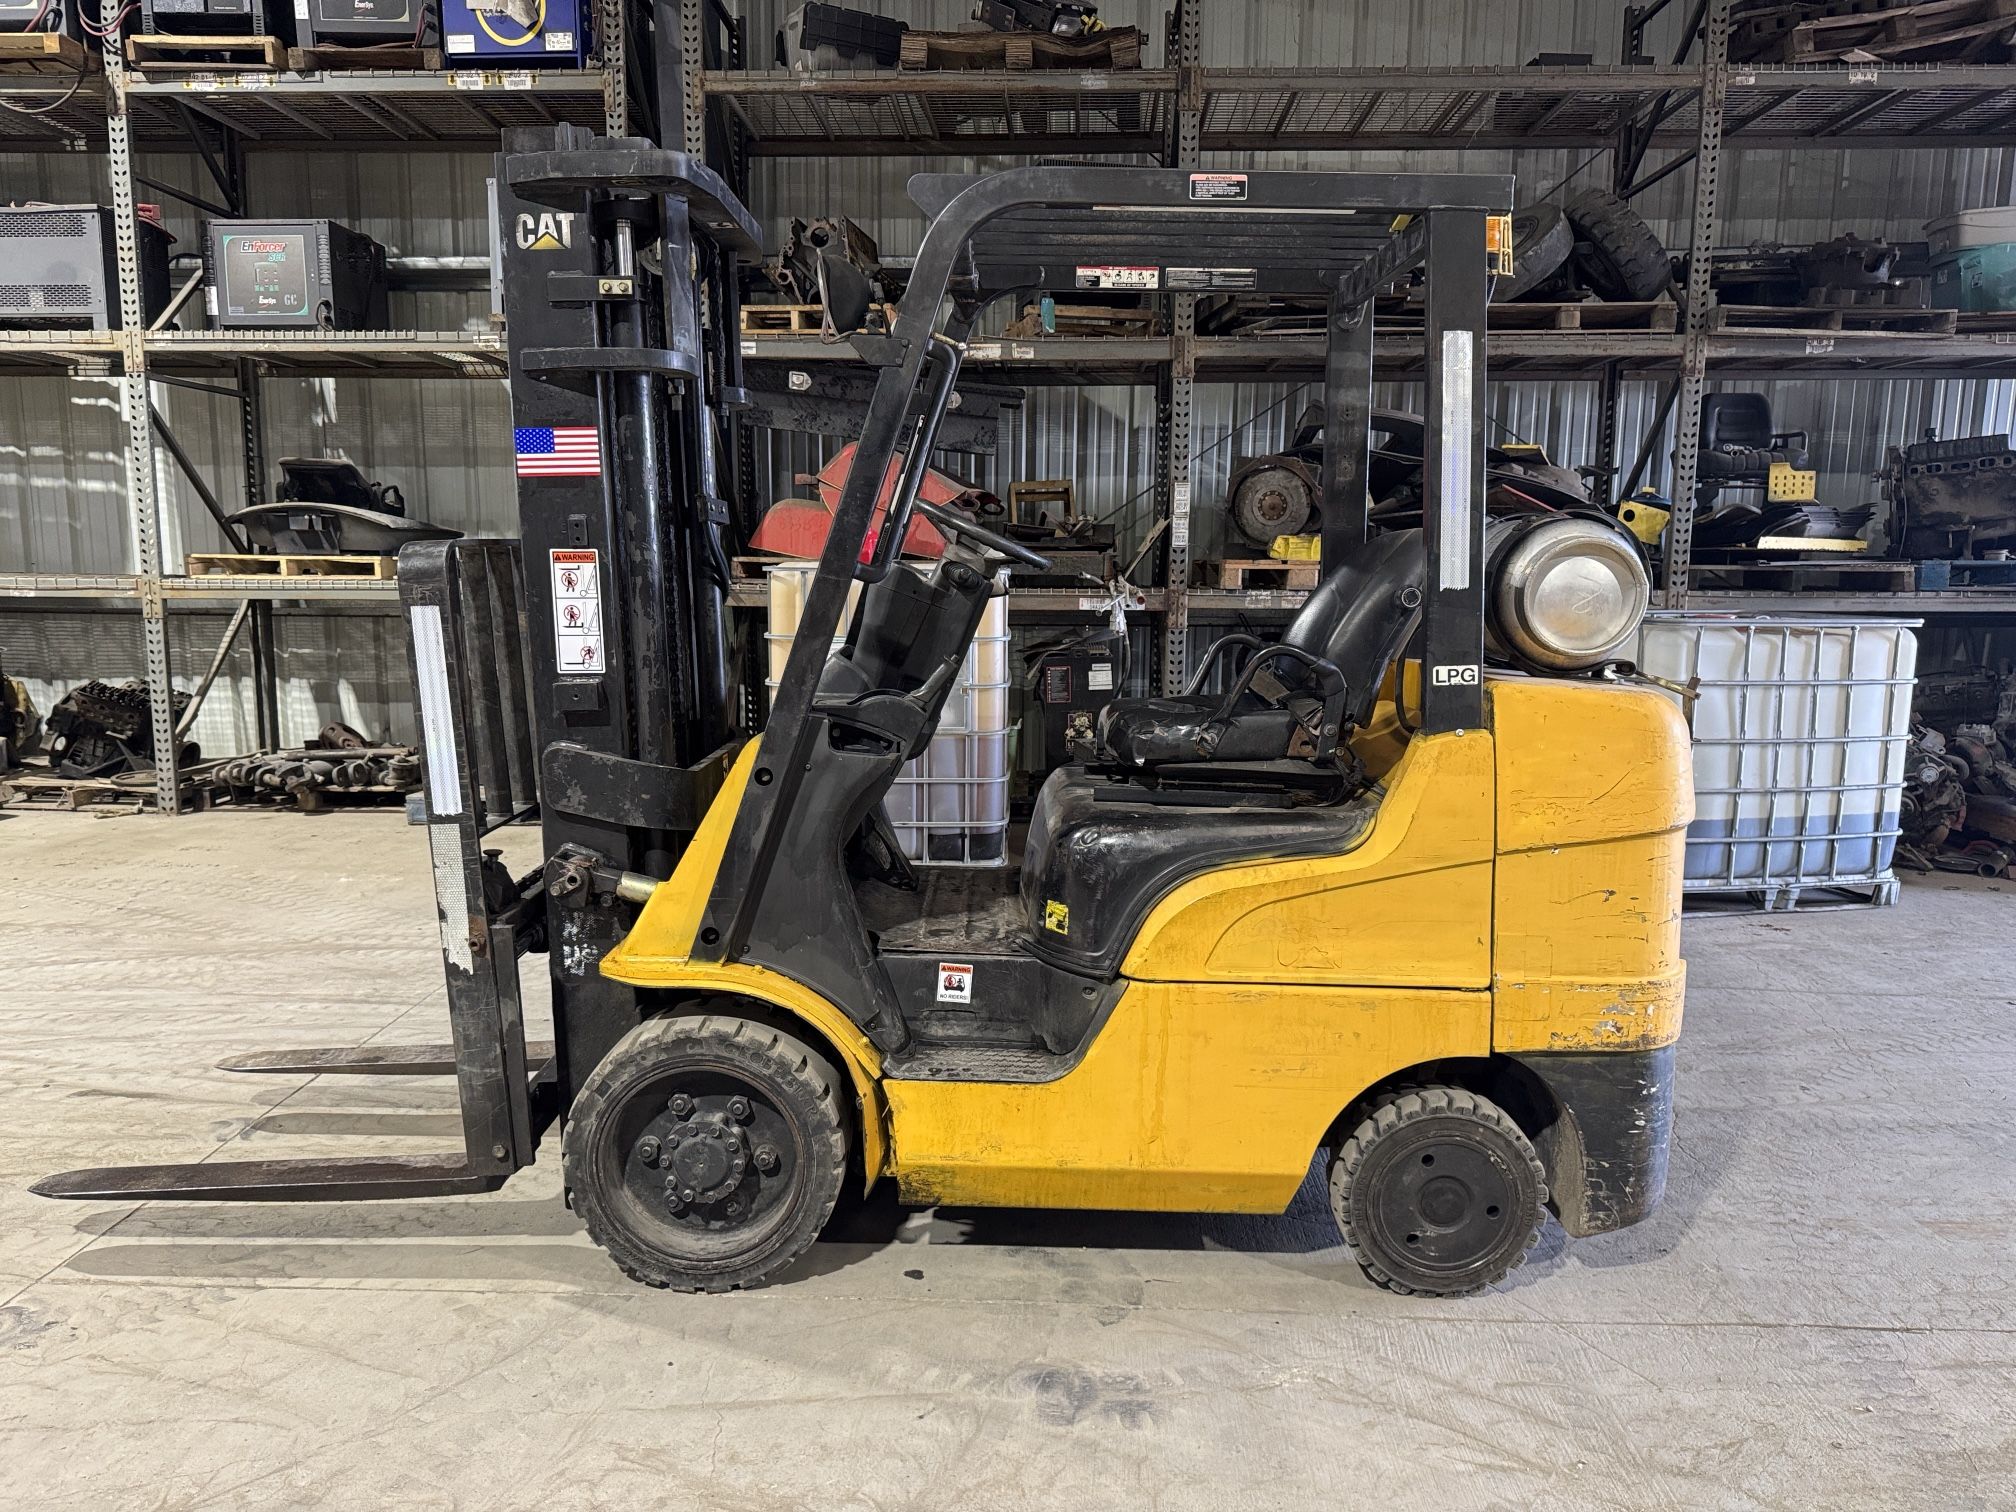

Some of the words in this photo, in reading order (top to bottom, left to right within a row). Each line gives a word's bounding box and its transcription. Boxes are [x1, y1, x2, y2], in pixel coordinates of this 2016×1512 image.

[515, 212, 574, 250] CAT
[241, 241, 286, 252] EnForcer
[561, 553, 594, 561] WARNING
[1435, 667, 1476, 684] LPG
